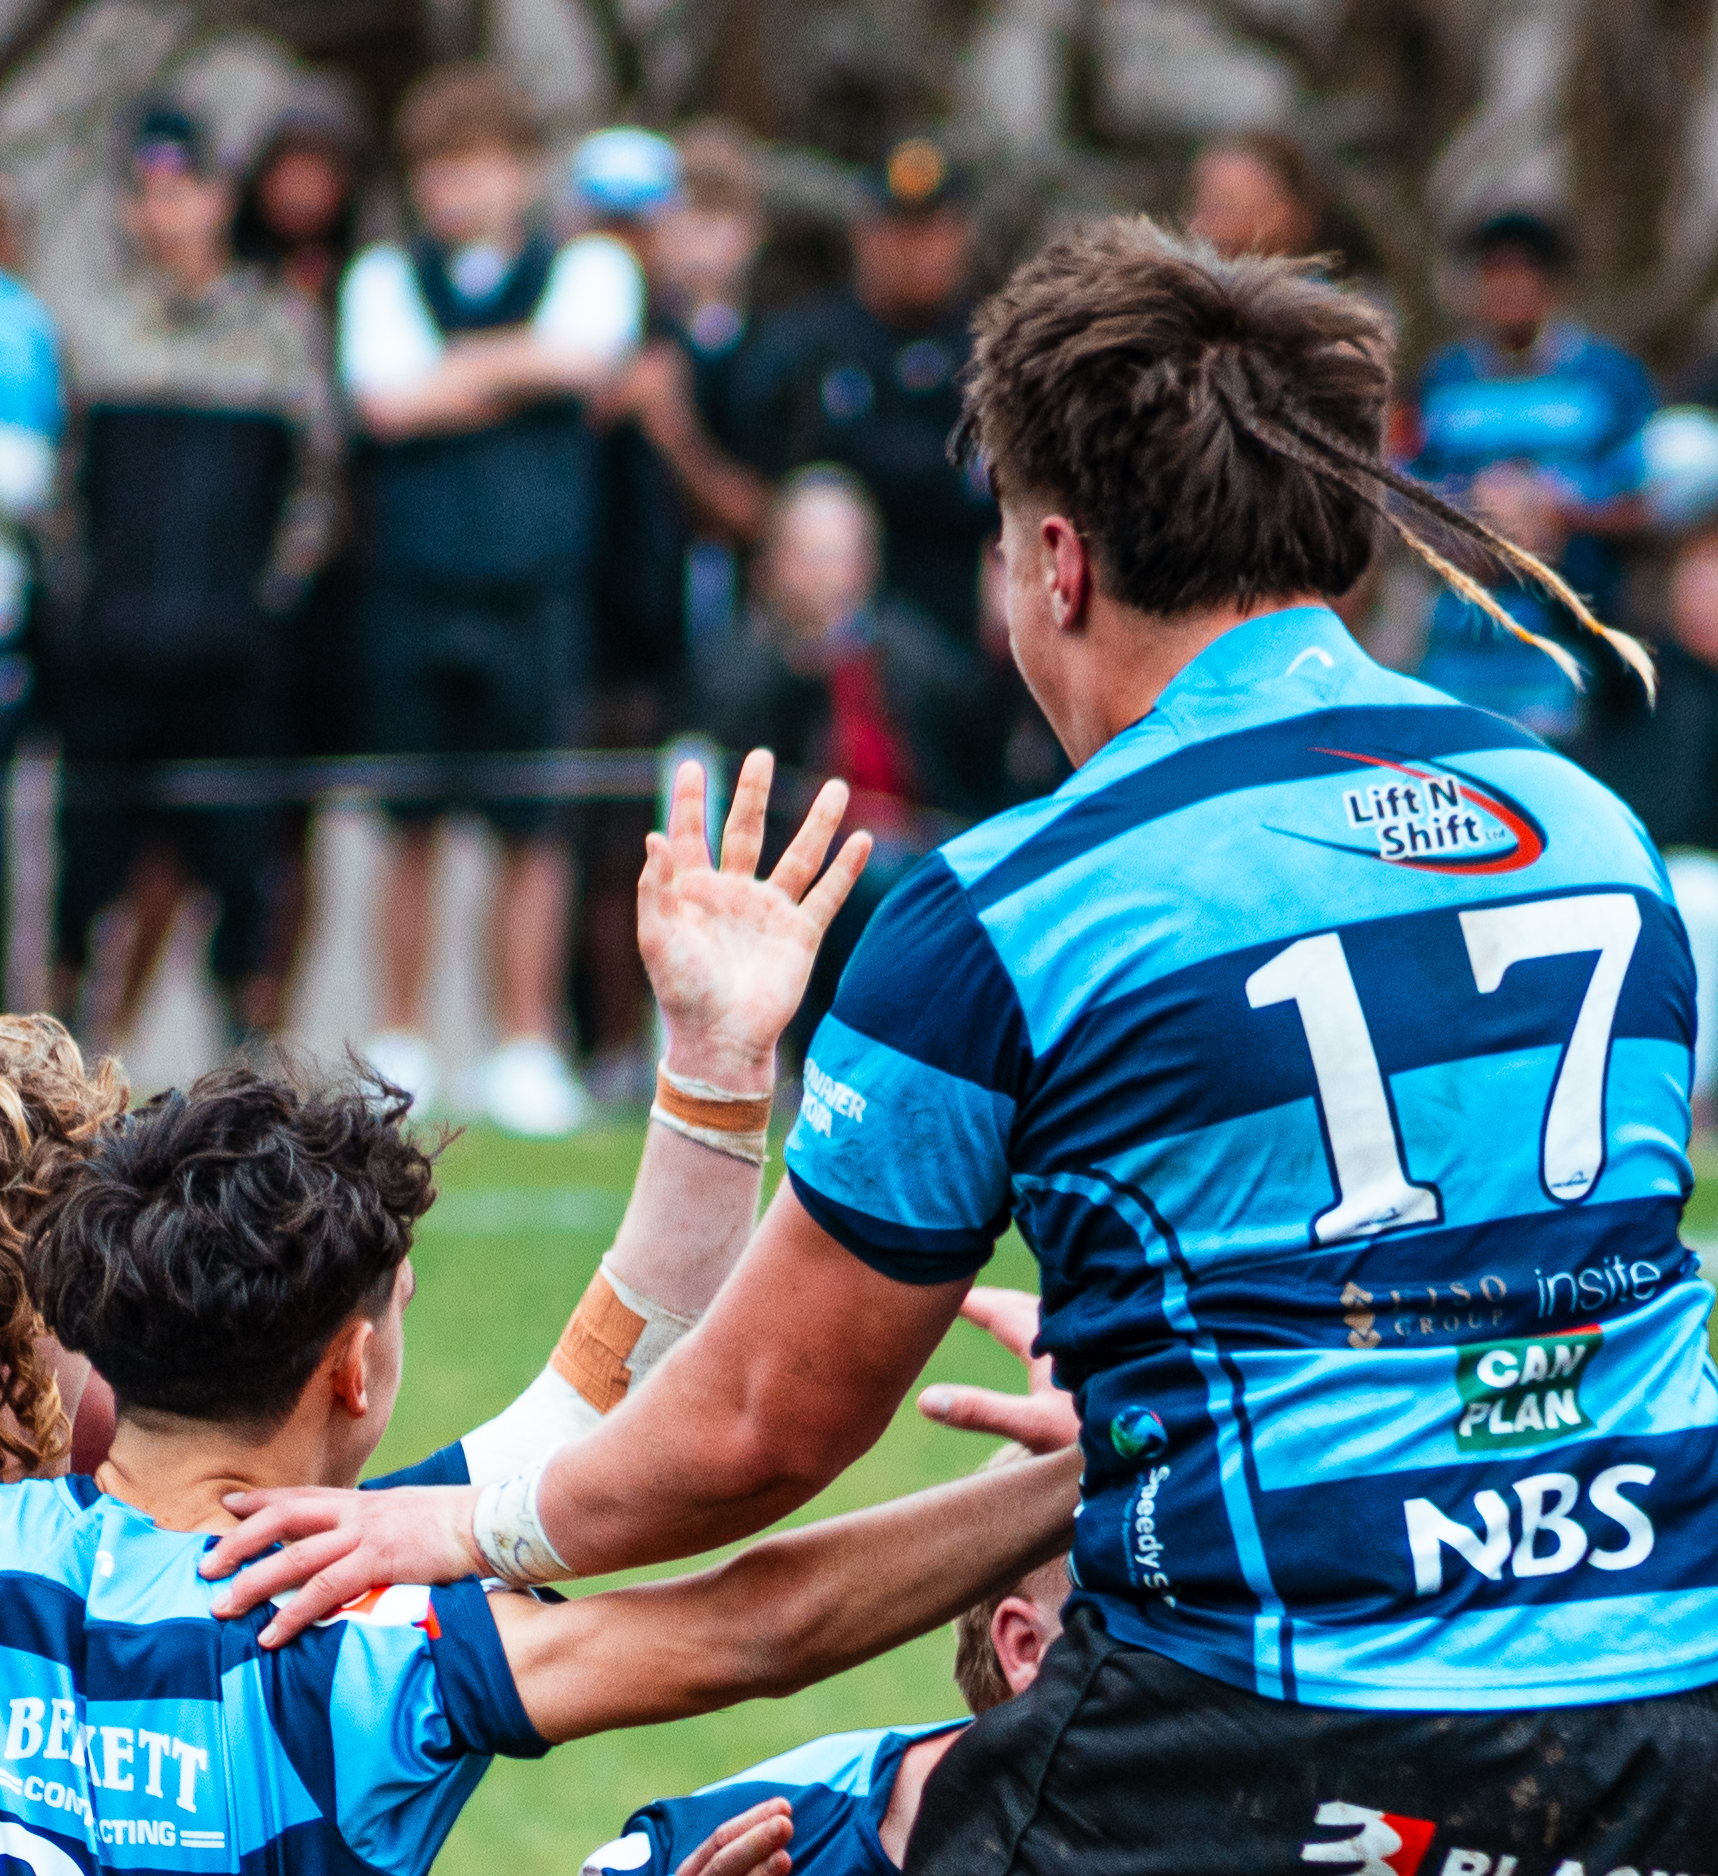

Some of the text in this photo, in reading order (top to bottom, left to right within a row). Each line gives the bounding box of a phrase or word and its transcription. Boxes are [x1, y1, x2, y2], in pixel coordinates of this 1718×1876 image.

[1349, 779, 1459, 824] Lift N
[1382, 813, 1479, 856] Shift
[1244, 892, 1642, 1244] 17
[1534, 1254, 1662, 1319] insite
[1476, 1344, 1586, 1390] CAN
[1458, 1389, 1582, 1438] PLAN
[1403, 1463, 1658, 1596] NBS
